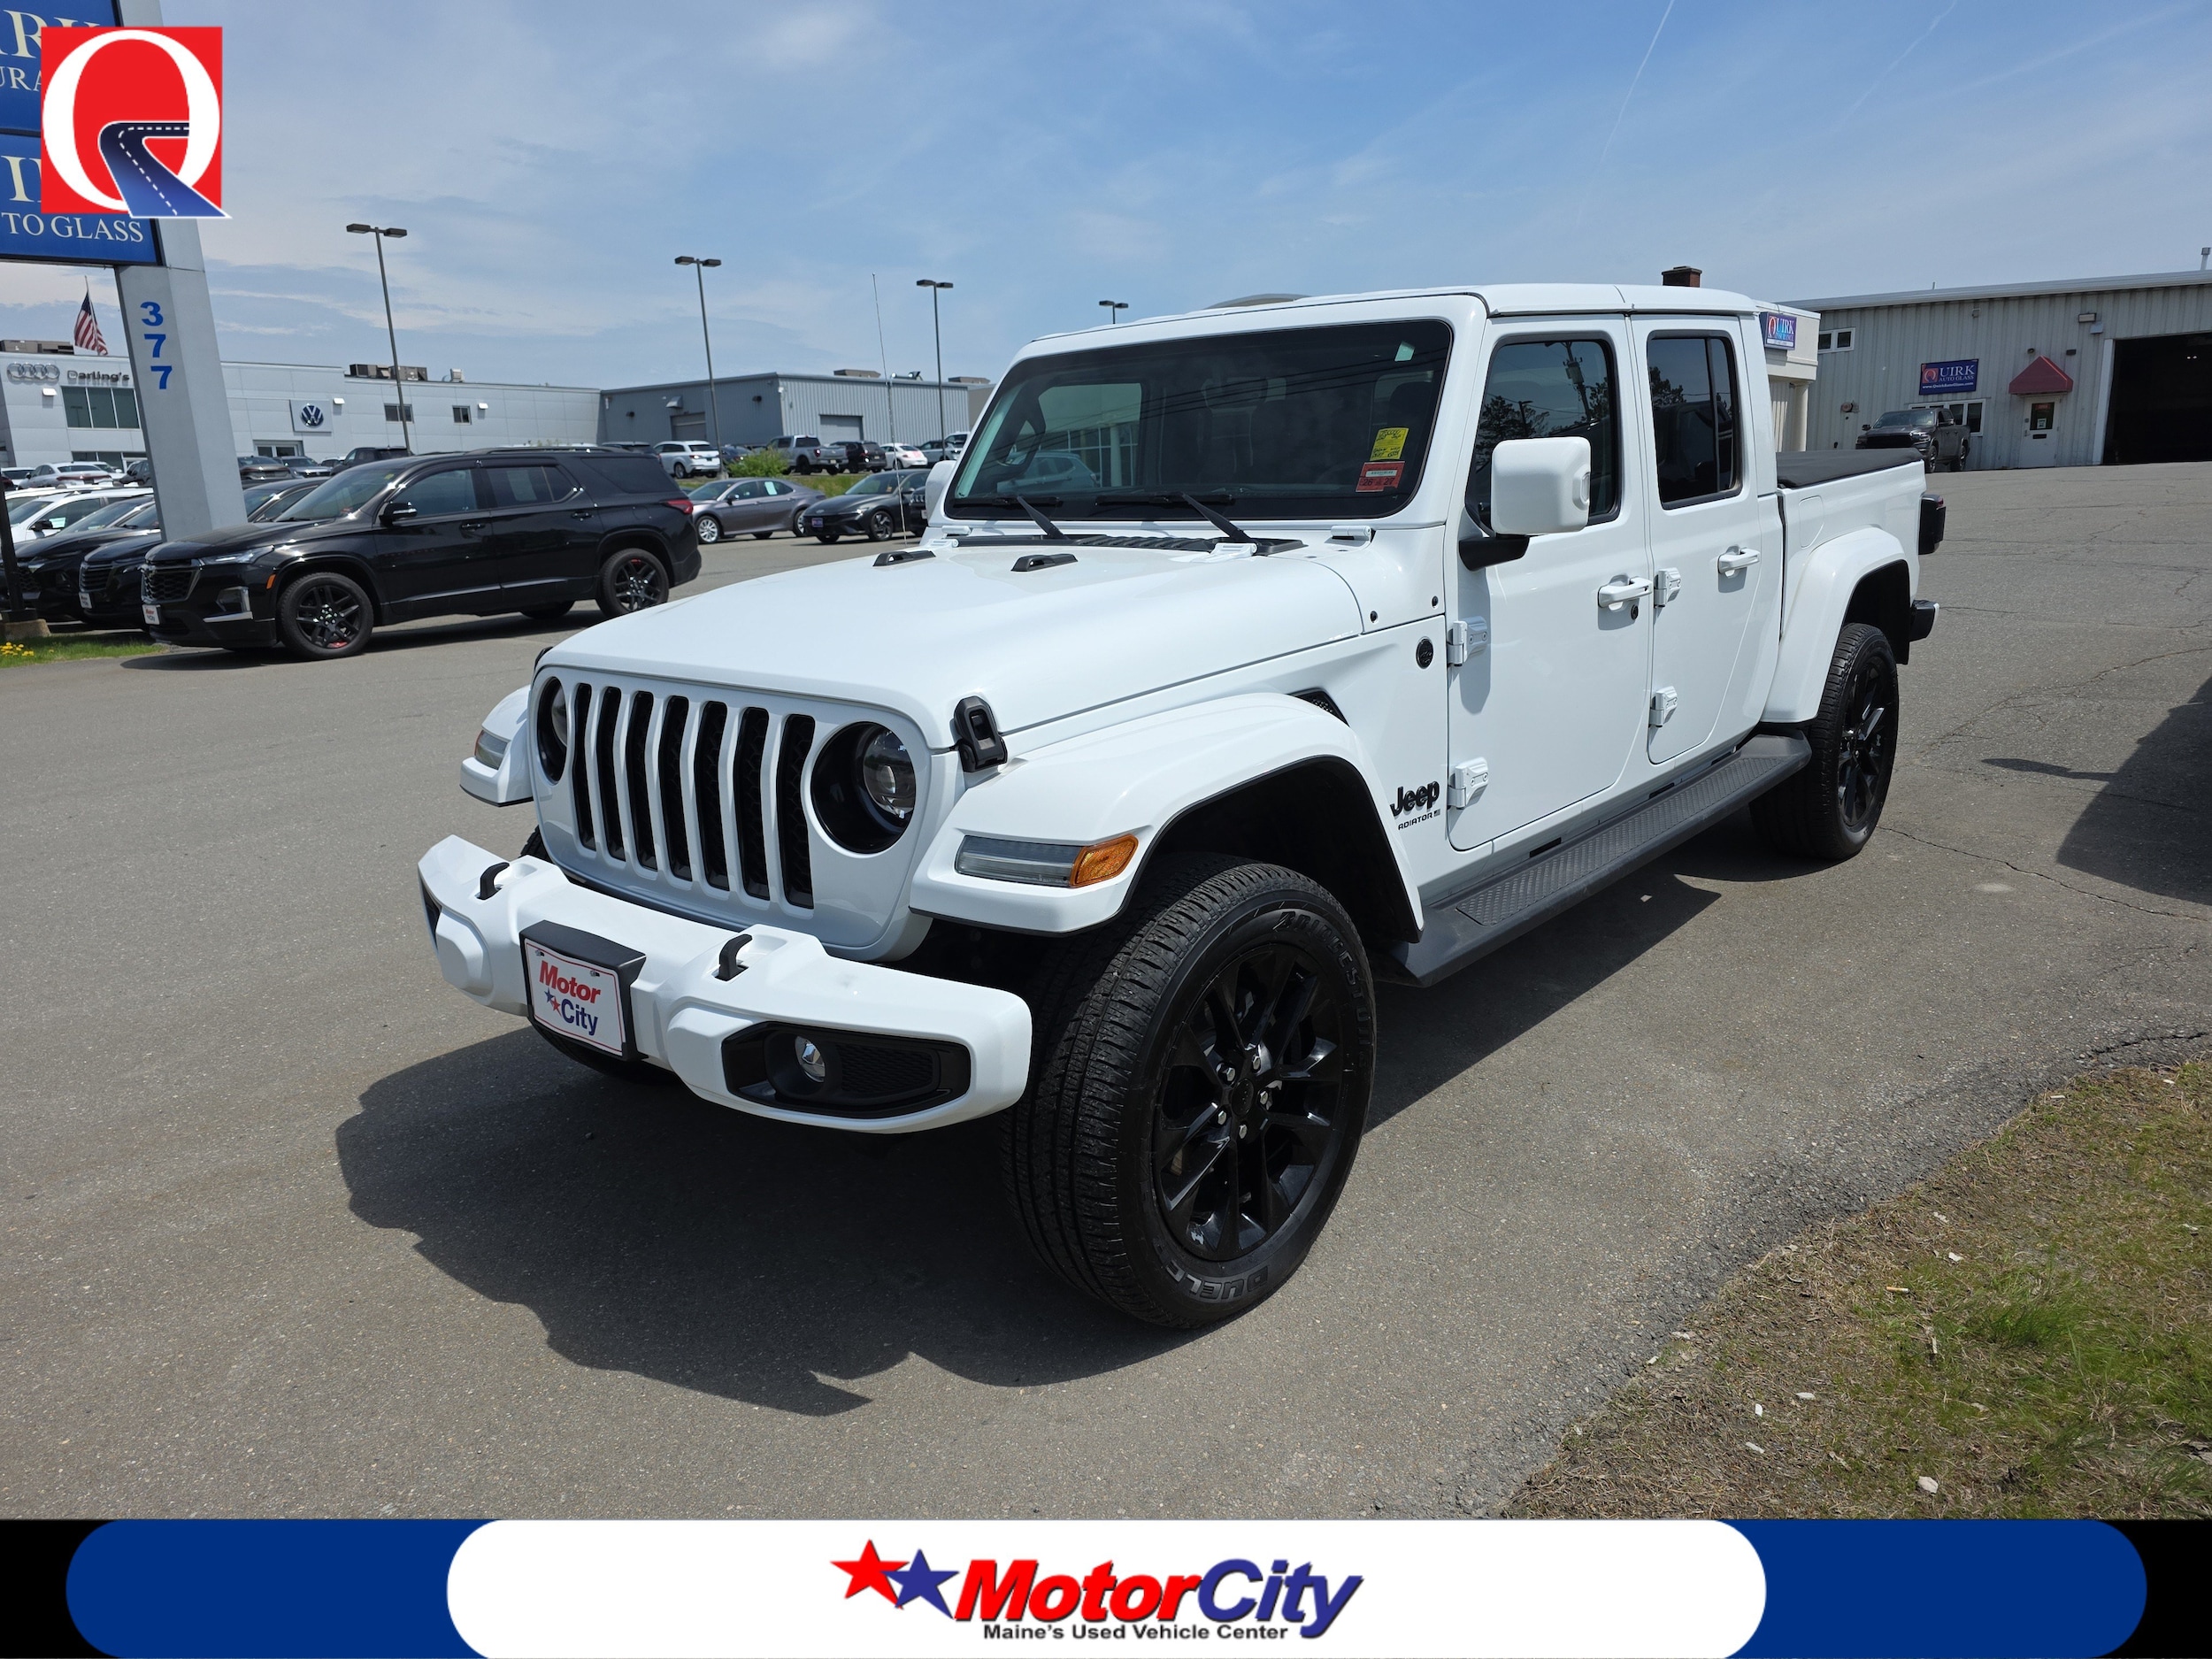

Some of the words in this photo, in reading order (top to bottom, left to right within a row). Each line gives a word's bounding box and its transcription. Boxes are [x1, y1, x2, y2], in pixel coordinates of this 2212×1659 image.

[50, 216, 144, 242] GLASS
[66, 370, 130, 382] Darling's
[1390, 781, 1440, 817] Jeep
[539, 960, 602, 1004] Motor
[561, 998, 598, 1036] City
